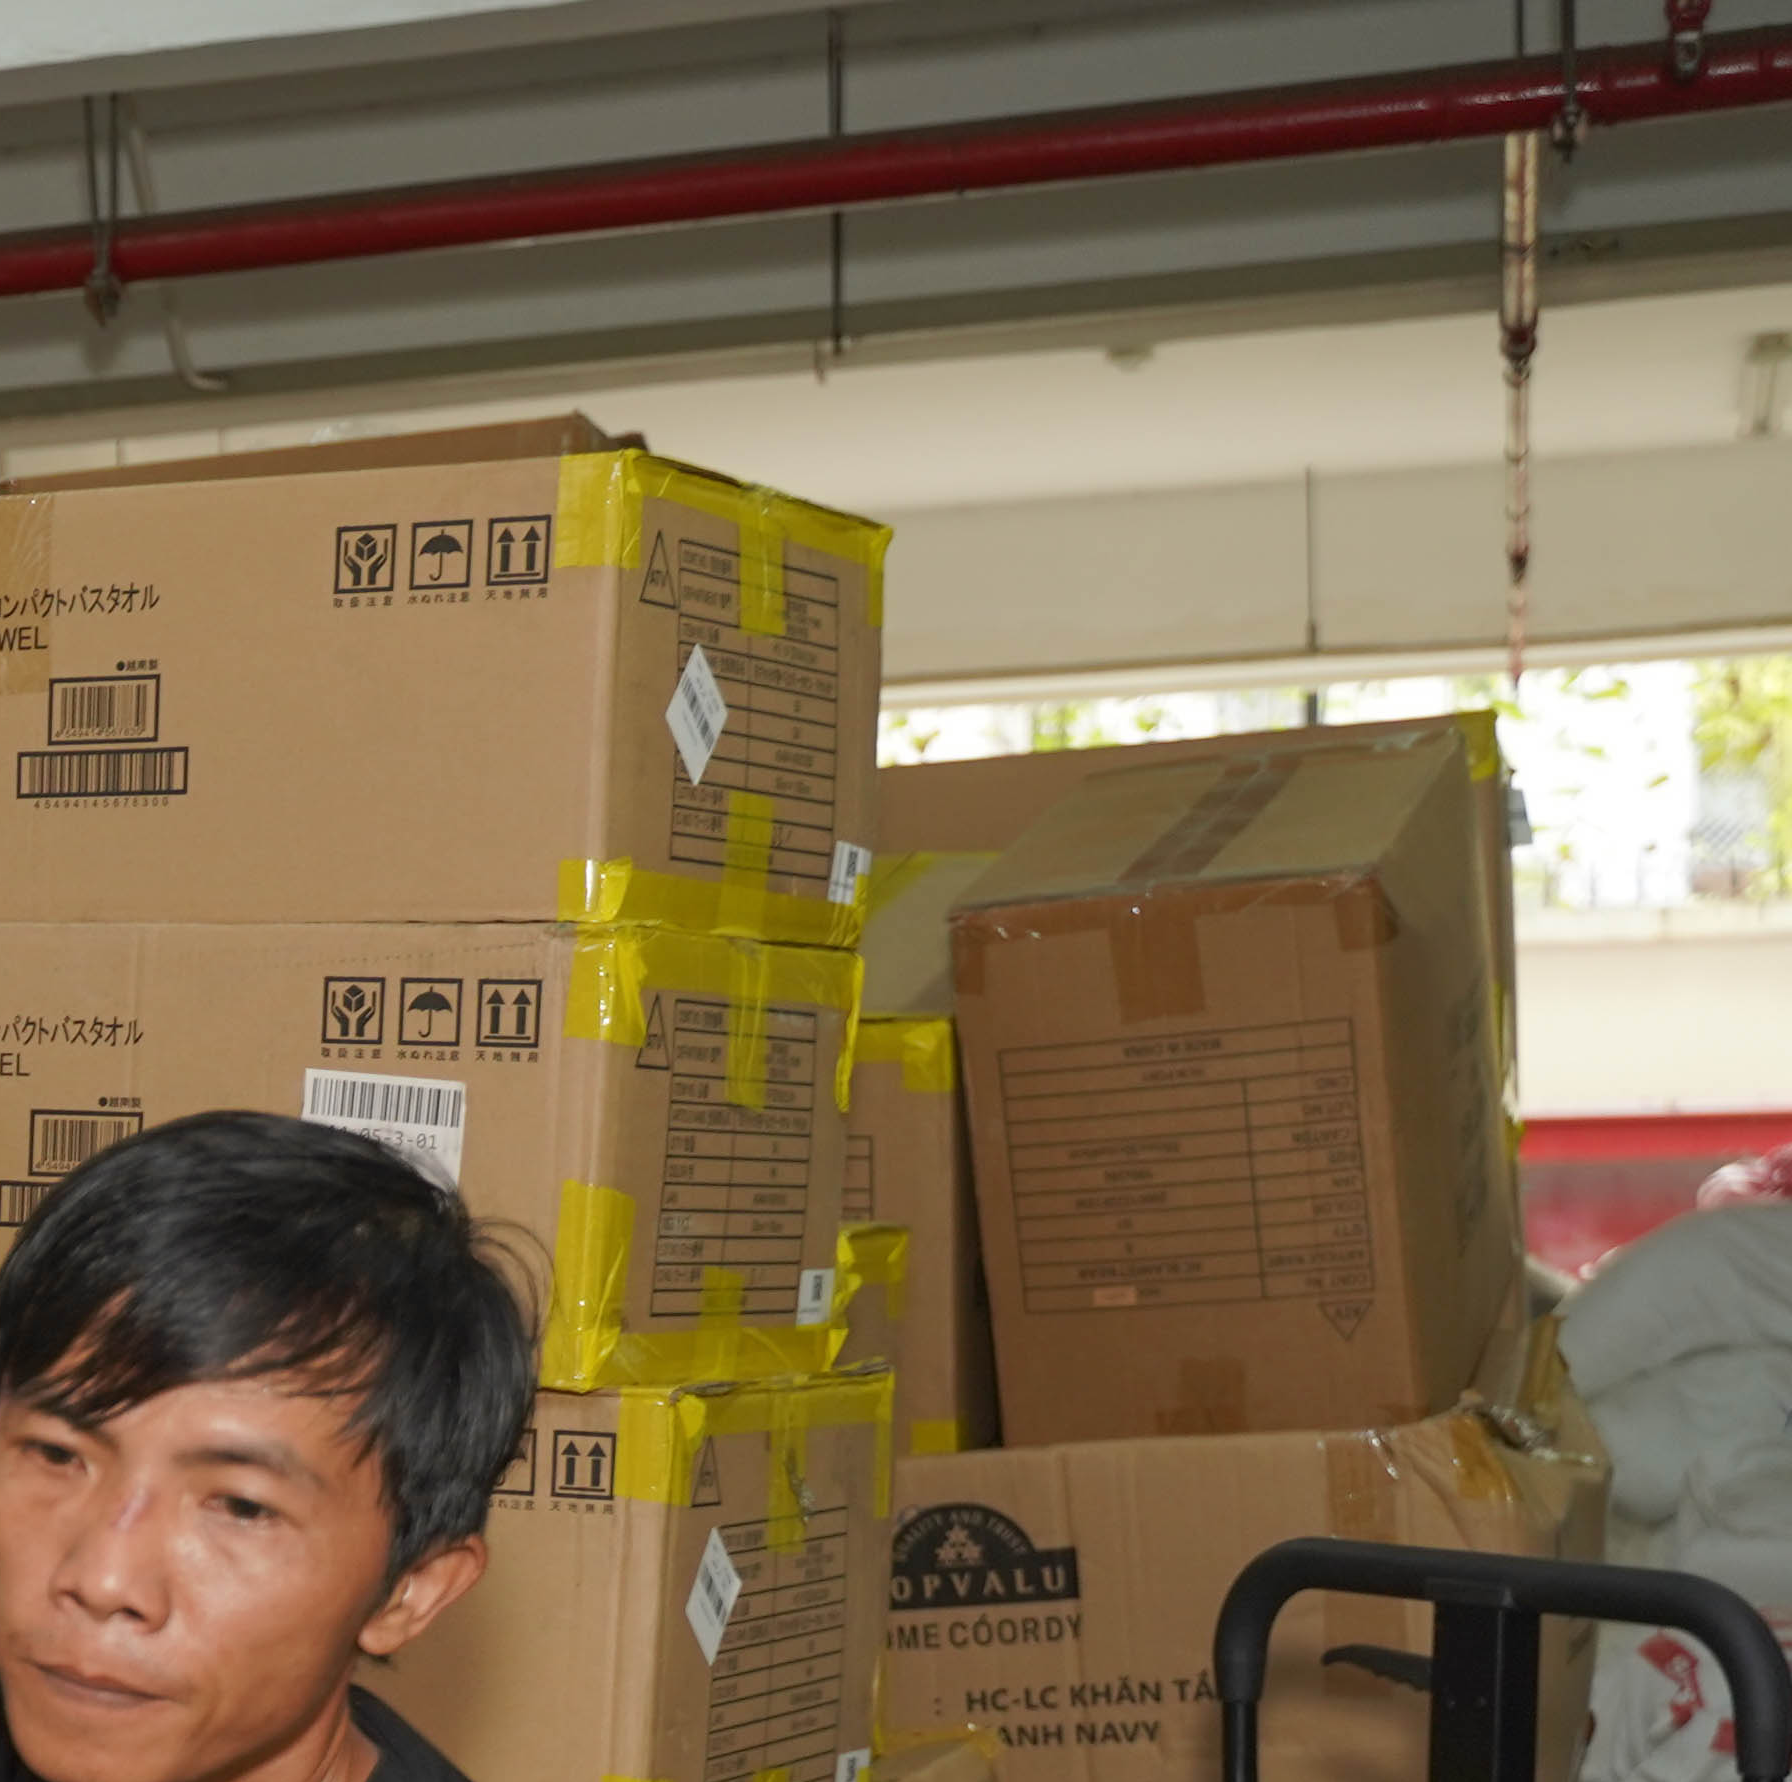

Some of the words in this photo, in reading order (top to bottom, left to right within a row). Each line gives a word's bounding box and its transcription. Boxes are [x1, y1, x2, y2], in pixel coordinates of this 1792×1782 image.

[948, 1510, 984, 1528] AND
[890, 1565, 1065, 1602] OPVALU
[965, 1685, 1058, 1713] HC-LC
[1076, 1720, 1163, 1746] NAVY
